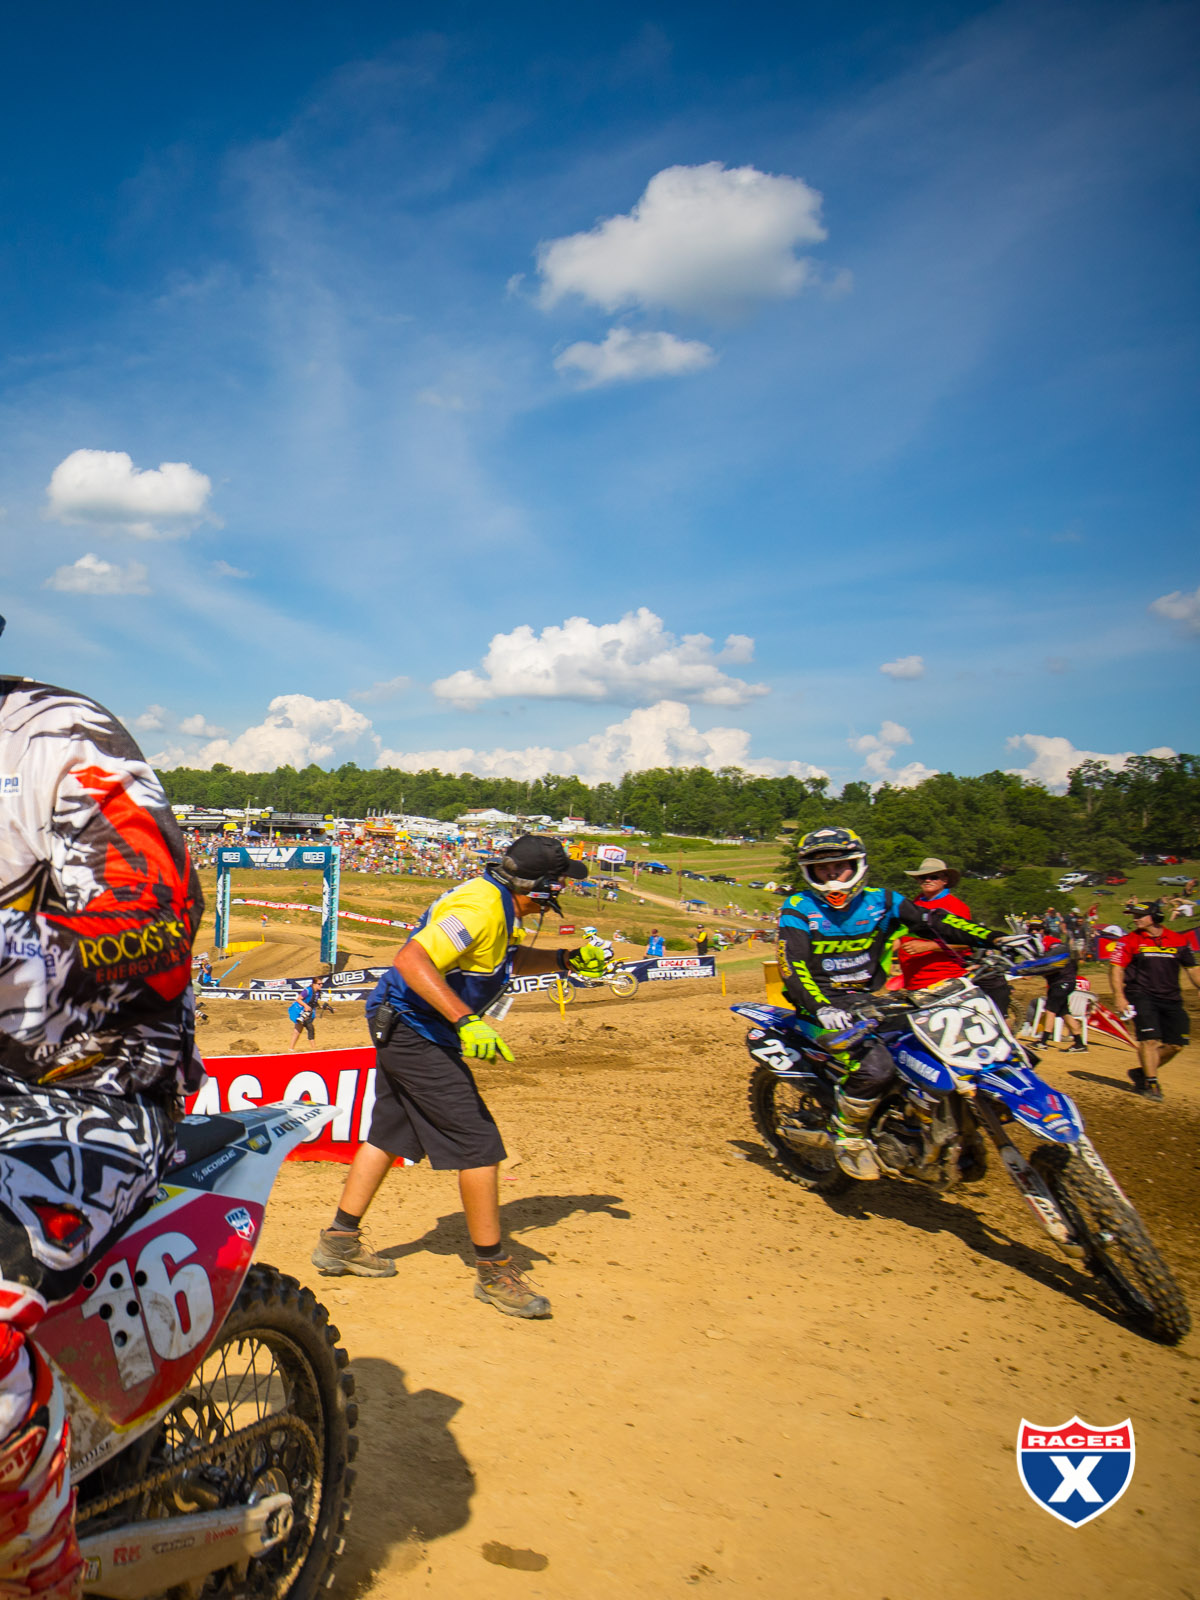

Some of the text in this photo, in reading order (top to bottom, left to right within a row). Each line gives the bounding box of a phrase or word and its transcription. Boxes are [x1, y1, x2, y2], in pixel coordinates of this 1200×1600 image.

[245, 847, 298, 863] FLY
[272, 1107, 321, 1138] DUNLOP
[80, 1231, 215, 1392] 16
